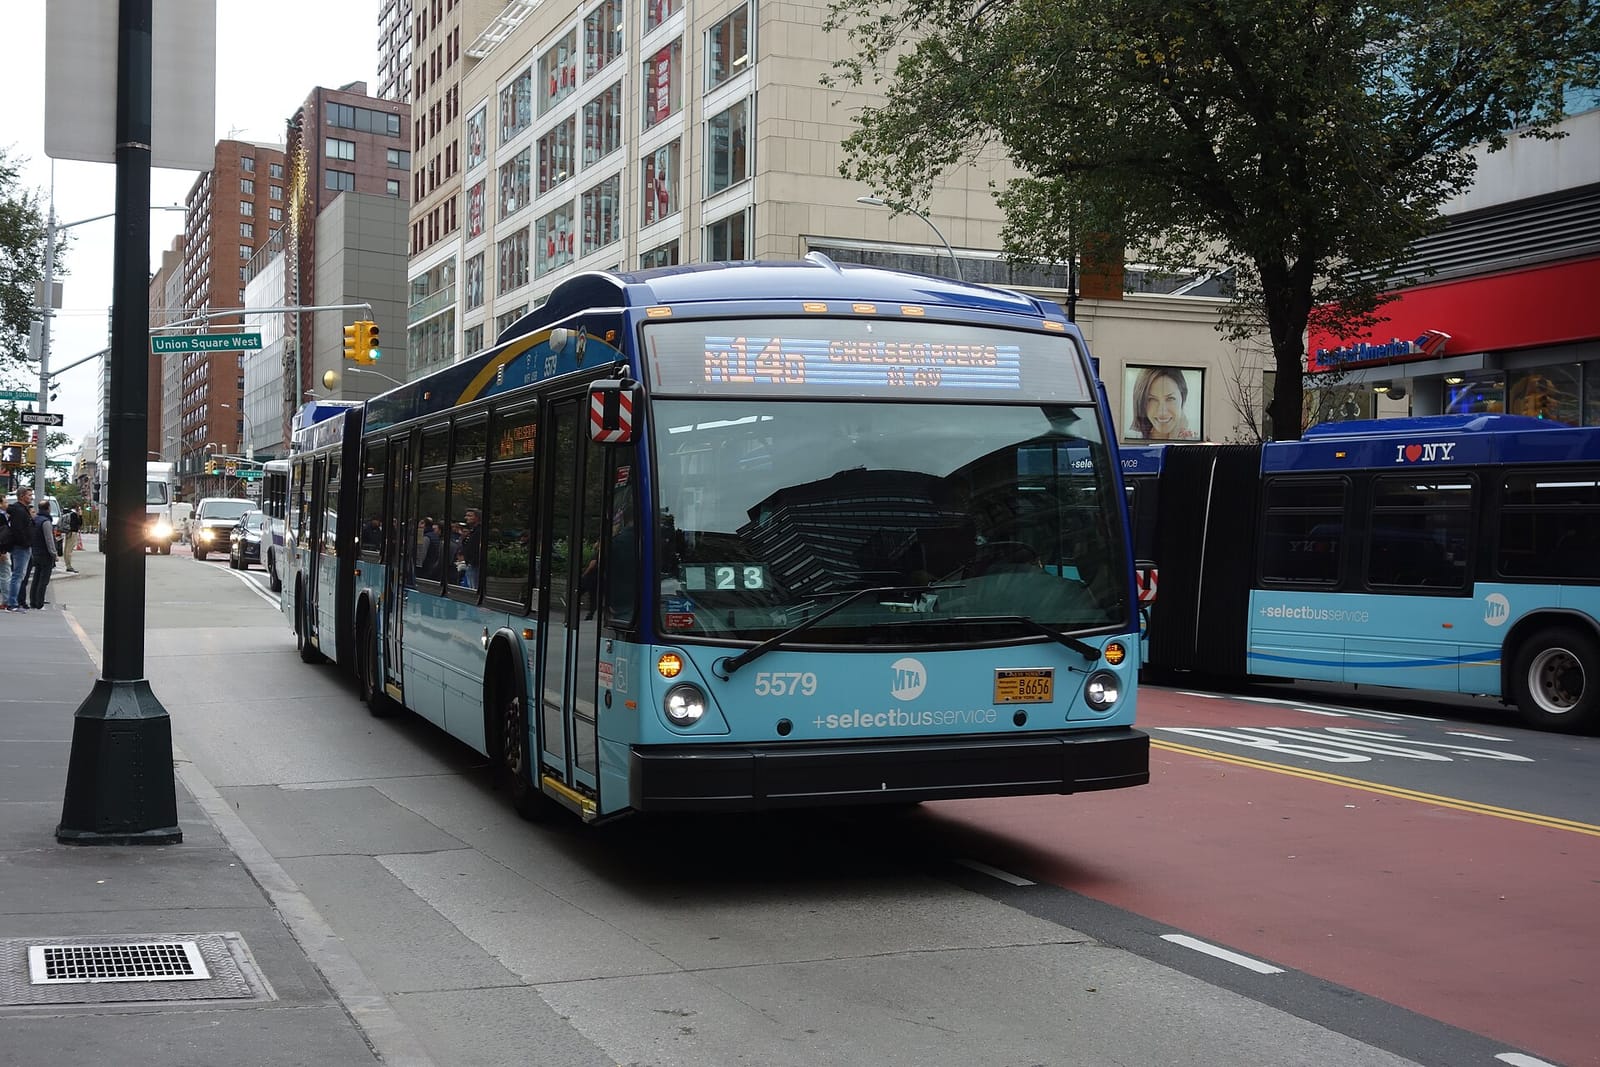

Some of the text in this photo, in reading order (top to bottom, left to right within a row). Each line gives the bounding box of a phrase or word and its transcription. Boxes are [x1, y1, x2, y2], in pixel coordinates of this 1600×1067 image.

[156, 337, 258, 350] Union Square West
[1360, 338, 1411, 360] America
[704, 336, 998, 384] M14D CHELSEA PIERS
[887, 366, 943, 387] 11 AV
[754, 672, 817, 697] 5579
[1154, 726, 1535, 763] BUS
